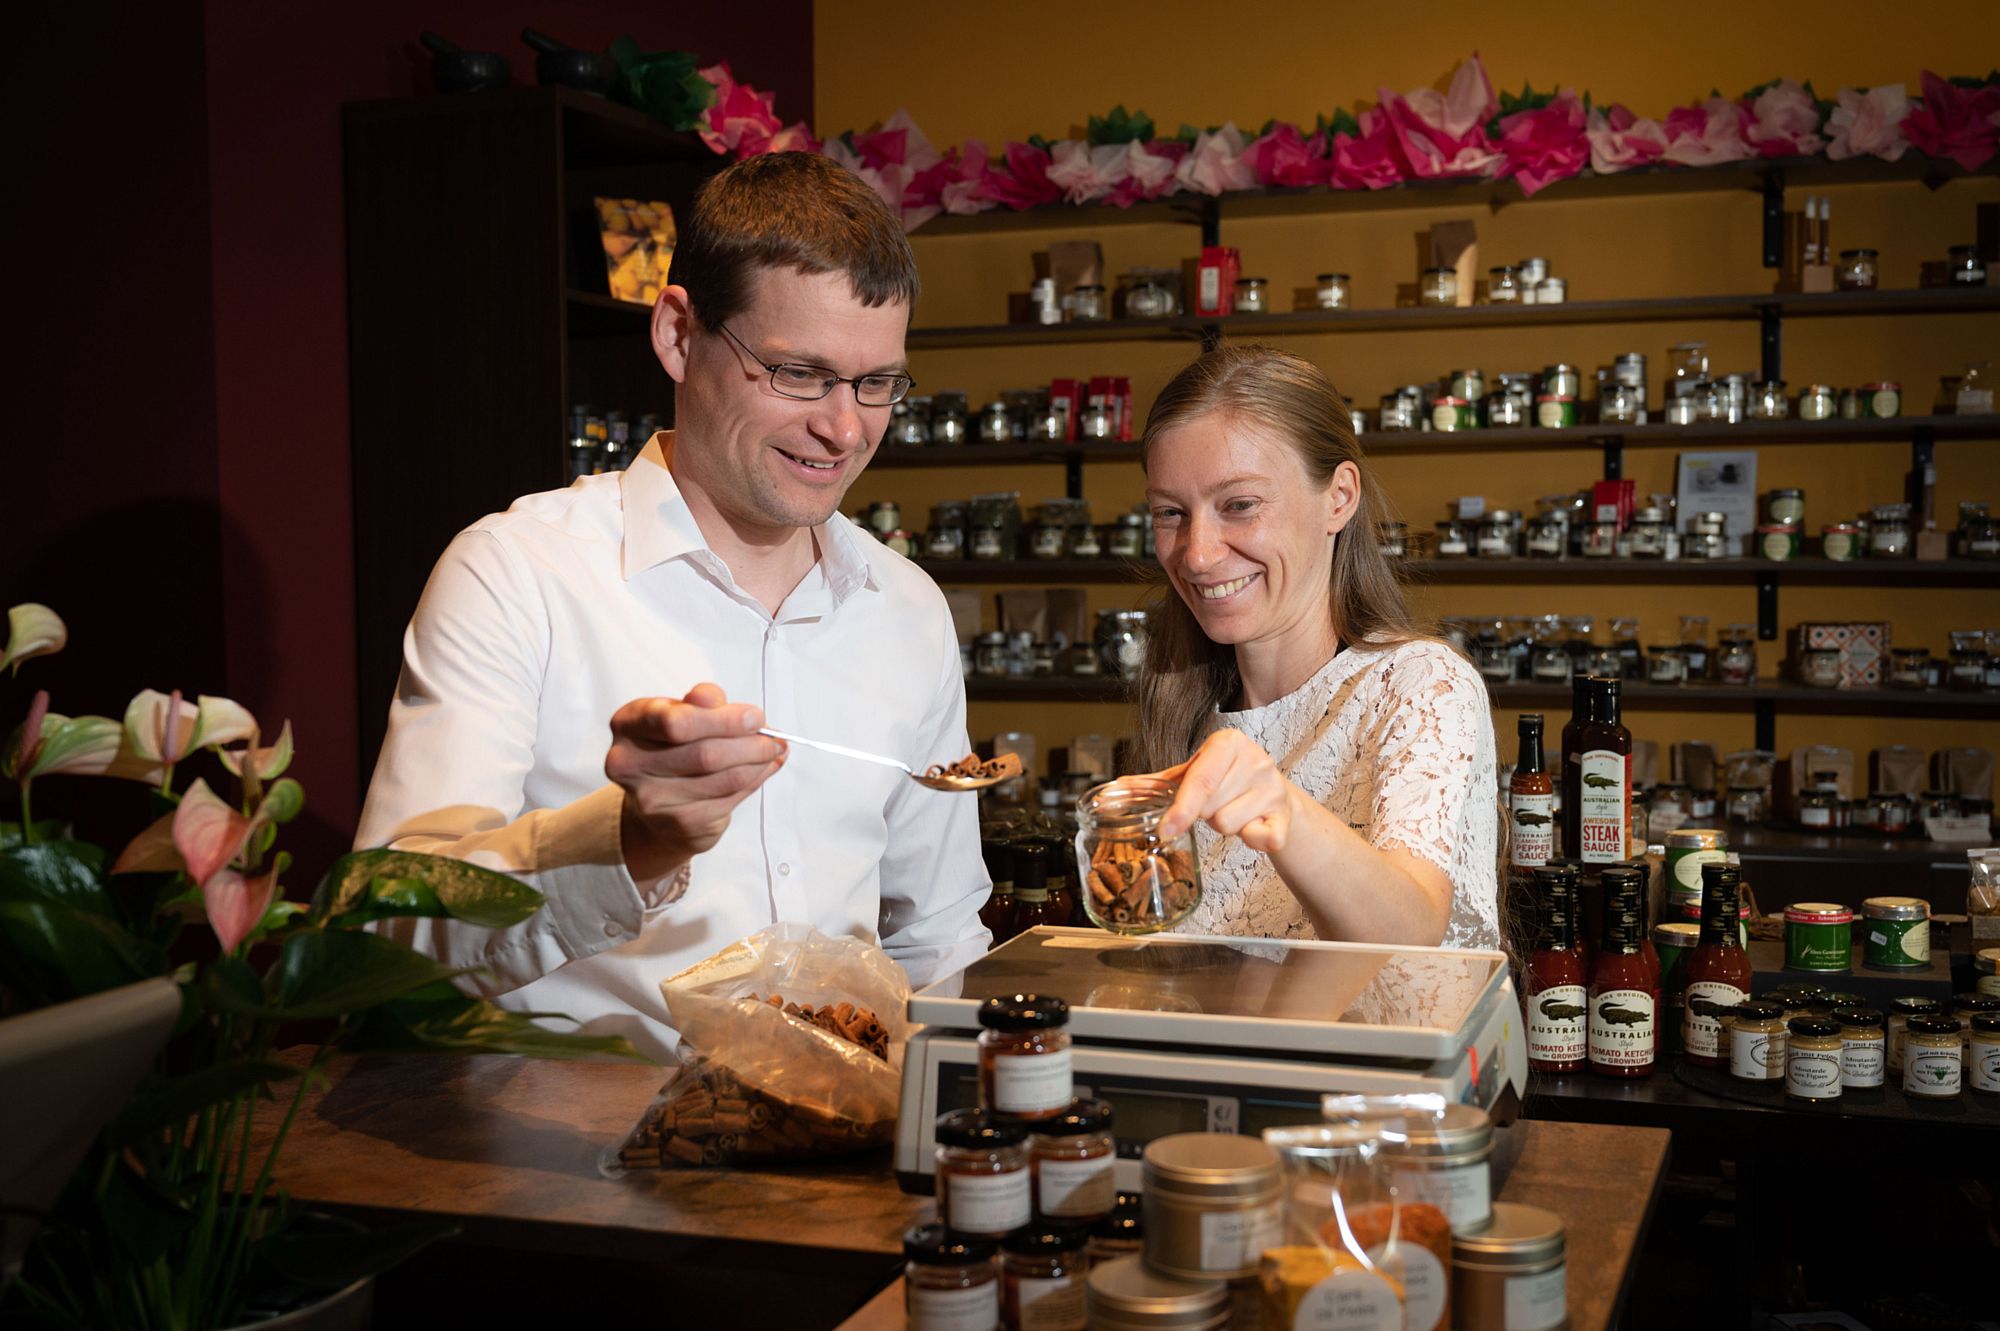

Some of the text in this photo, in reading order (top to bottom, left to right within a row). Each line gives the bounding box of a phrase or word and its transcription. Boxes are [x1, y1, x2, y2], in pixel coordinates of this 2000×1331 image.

[1583, 825, 1620, 842] STEAK
[1516, 844, 1550, 852] PEPPER
[1583, 842, 1620, 853] SAUCE
[1518, 852, 1549, 860] SAUCE
[1541, 990, 1556, 998] THE
[1600, 993, 1613, 1002] THE
[1531, 1043, 1564, 1052] TOMATO
[1591, 1046, 1621, 1058] TOMATO
[1608, 1057, 1648, 1065] GROWNUPS
[1794, 1065, 1827, 1074] Moutarde
